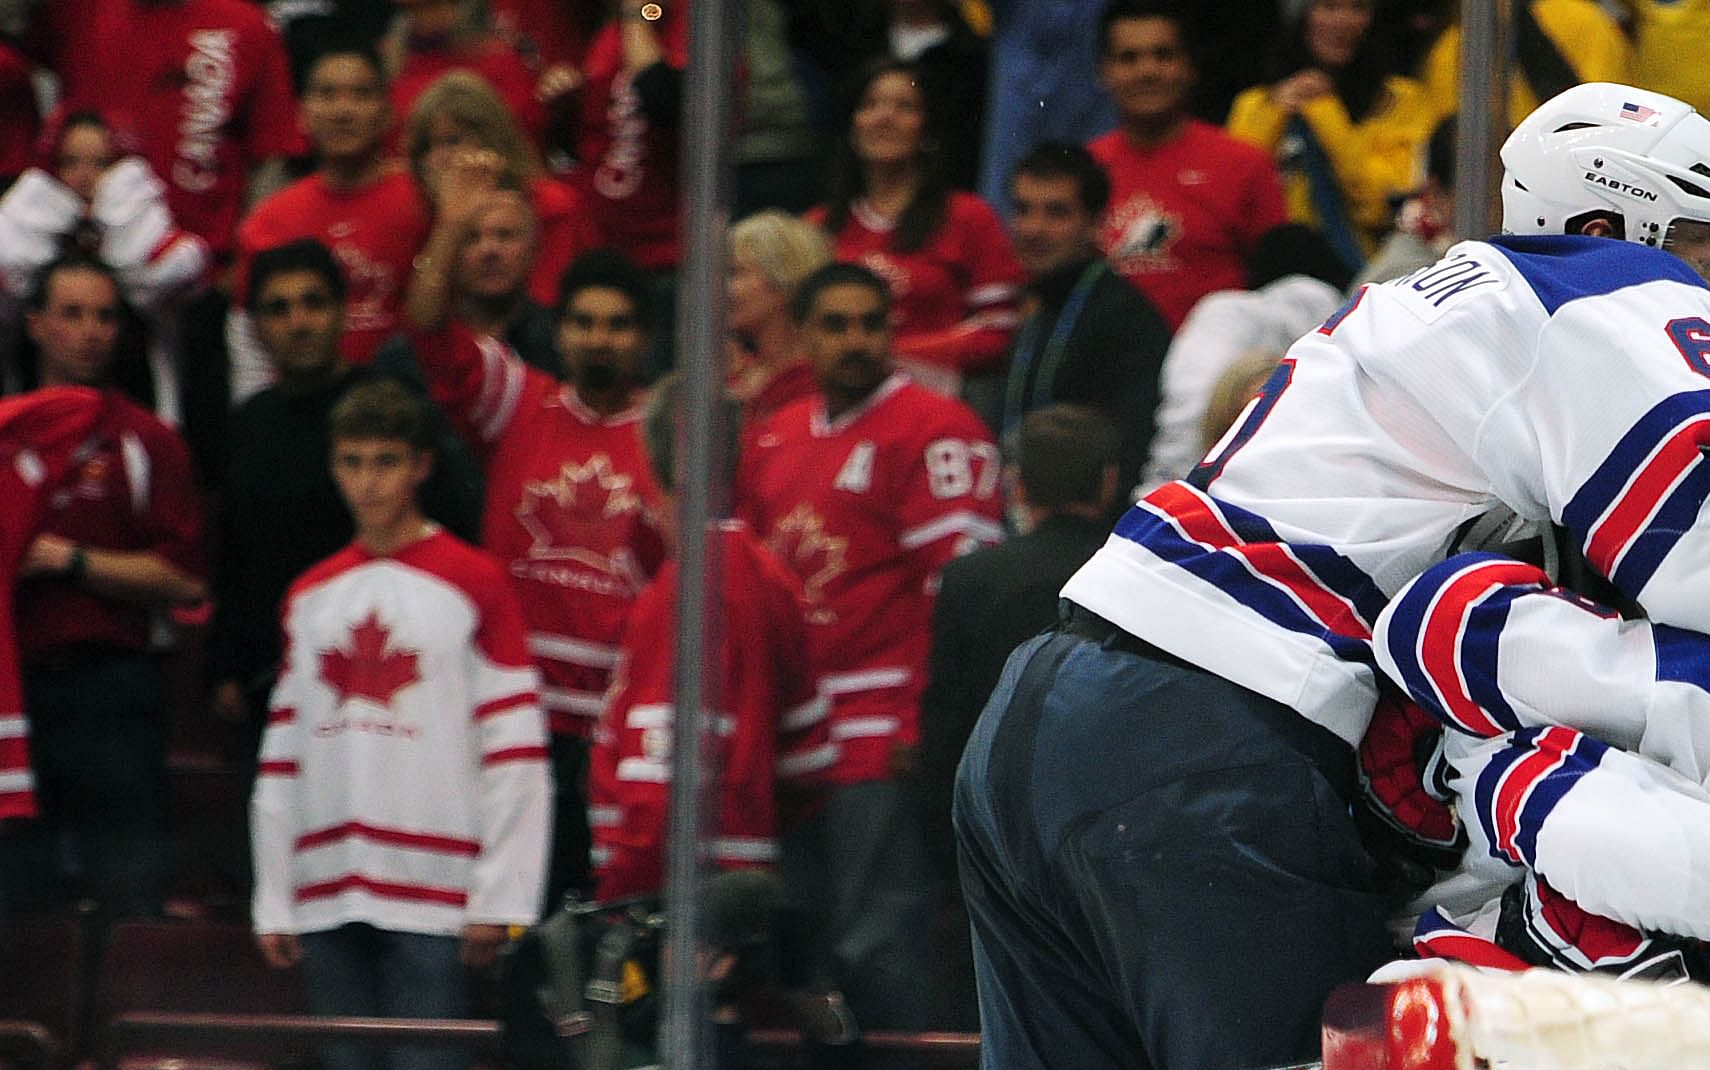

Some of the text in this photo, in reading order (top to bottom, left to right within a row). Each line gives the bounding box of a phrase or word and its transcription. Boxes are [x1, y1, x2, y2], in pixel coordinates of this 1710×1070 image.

[172, 28, 237, 193] CANADA
[1585, 172, 1658, 202] EASTON
[832, 440, 877, 494] A
[923, 438, 1000, 499] 87
